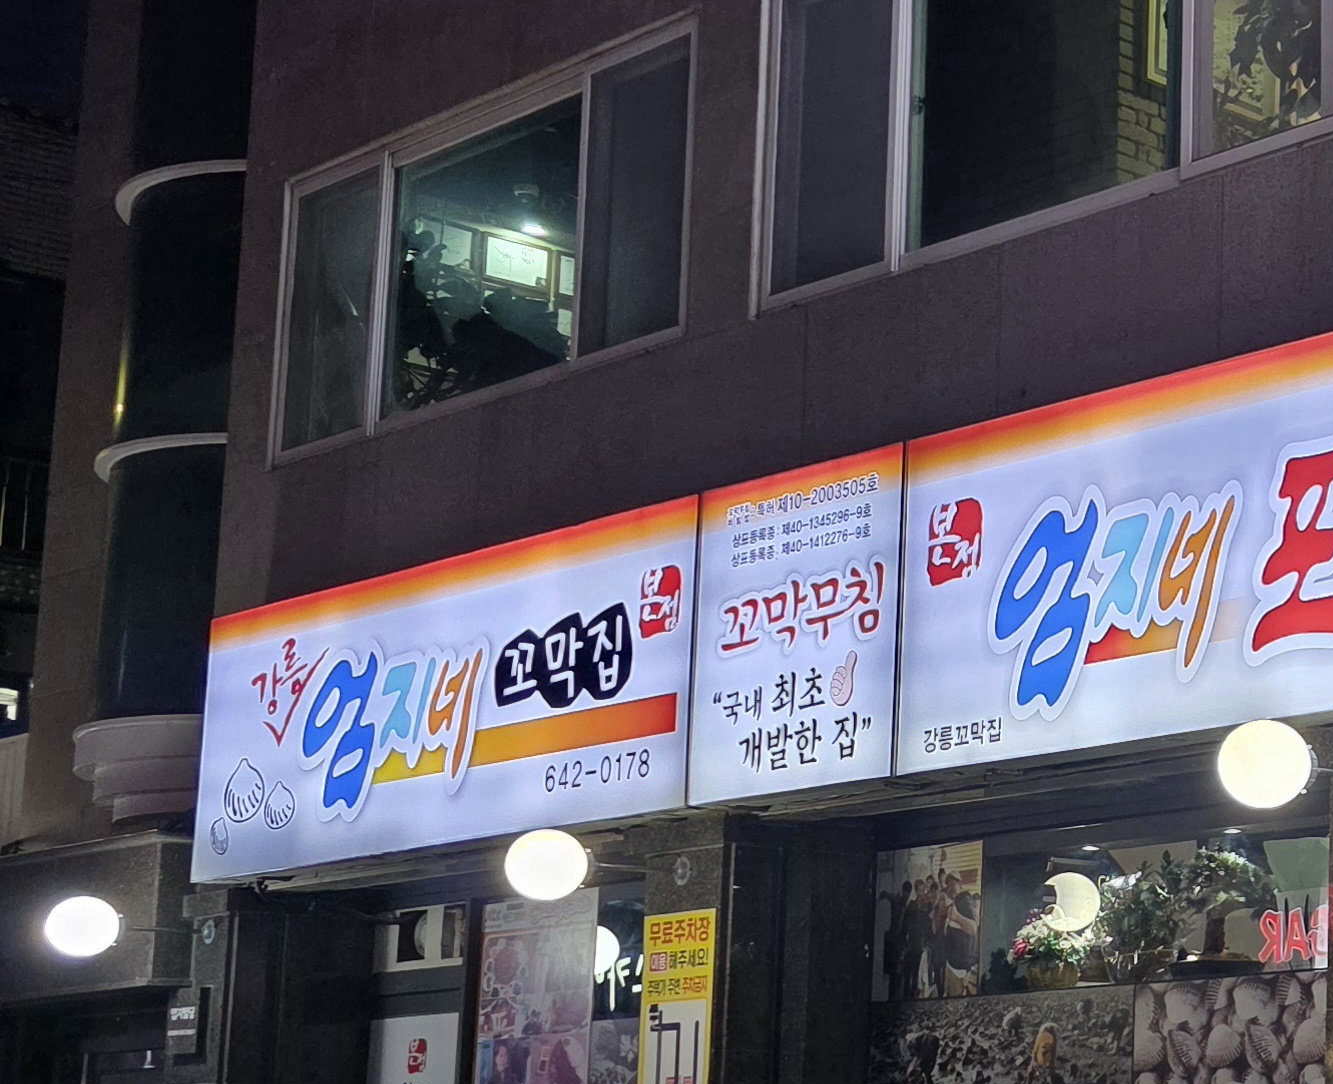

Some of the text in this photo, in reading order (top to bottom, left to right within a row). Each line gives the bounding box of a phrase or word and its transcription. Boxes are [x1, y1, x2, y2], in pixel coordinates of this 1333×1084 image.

[927, 497, 982, 588] 본점
[639, 564, 680, 640] 본점
[722, 561, 886, 650] 꼬막무침
[997, 496, 1235, 710] 엄지네
[251, 637, 329, 746] 강릉
[302, 608, 631, 808] 엄지네 꼬막집
[771, 674, 827, 713] 최초
[545, 749, 650, 793] 642-0178
[739, 714, 872, 773] 개발한 집”
[650, 916, 711, 946] 무료주차장
[650, 953, 667, 971] 이용
